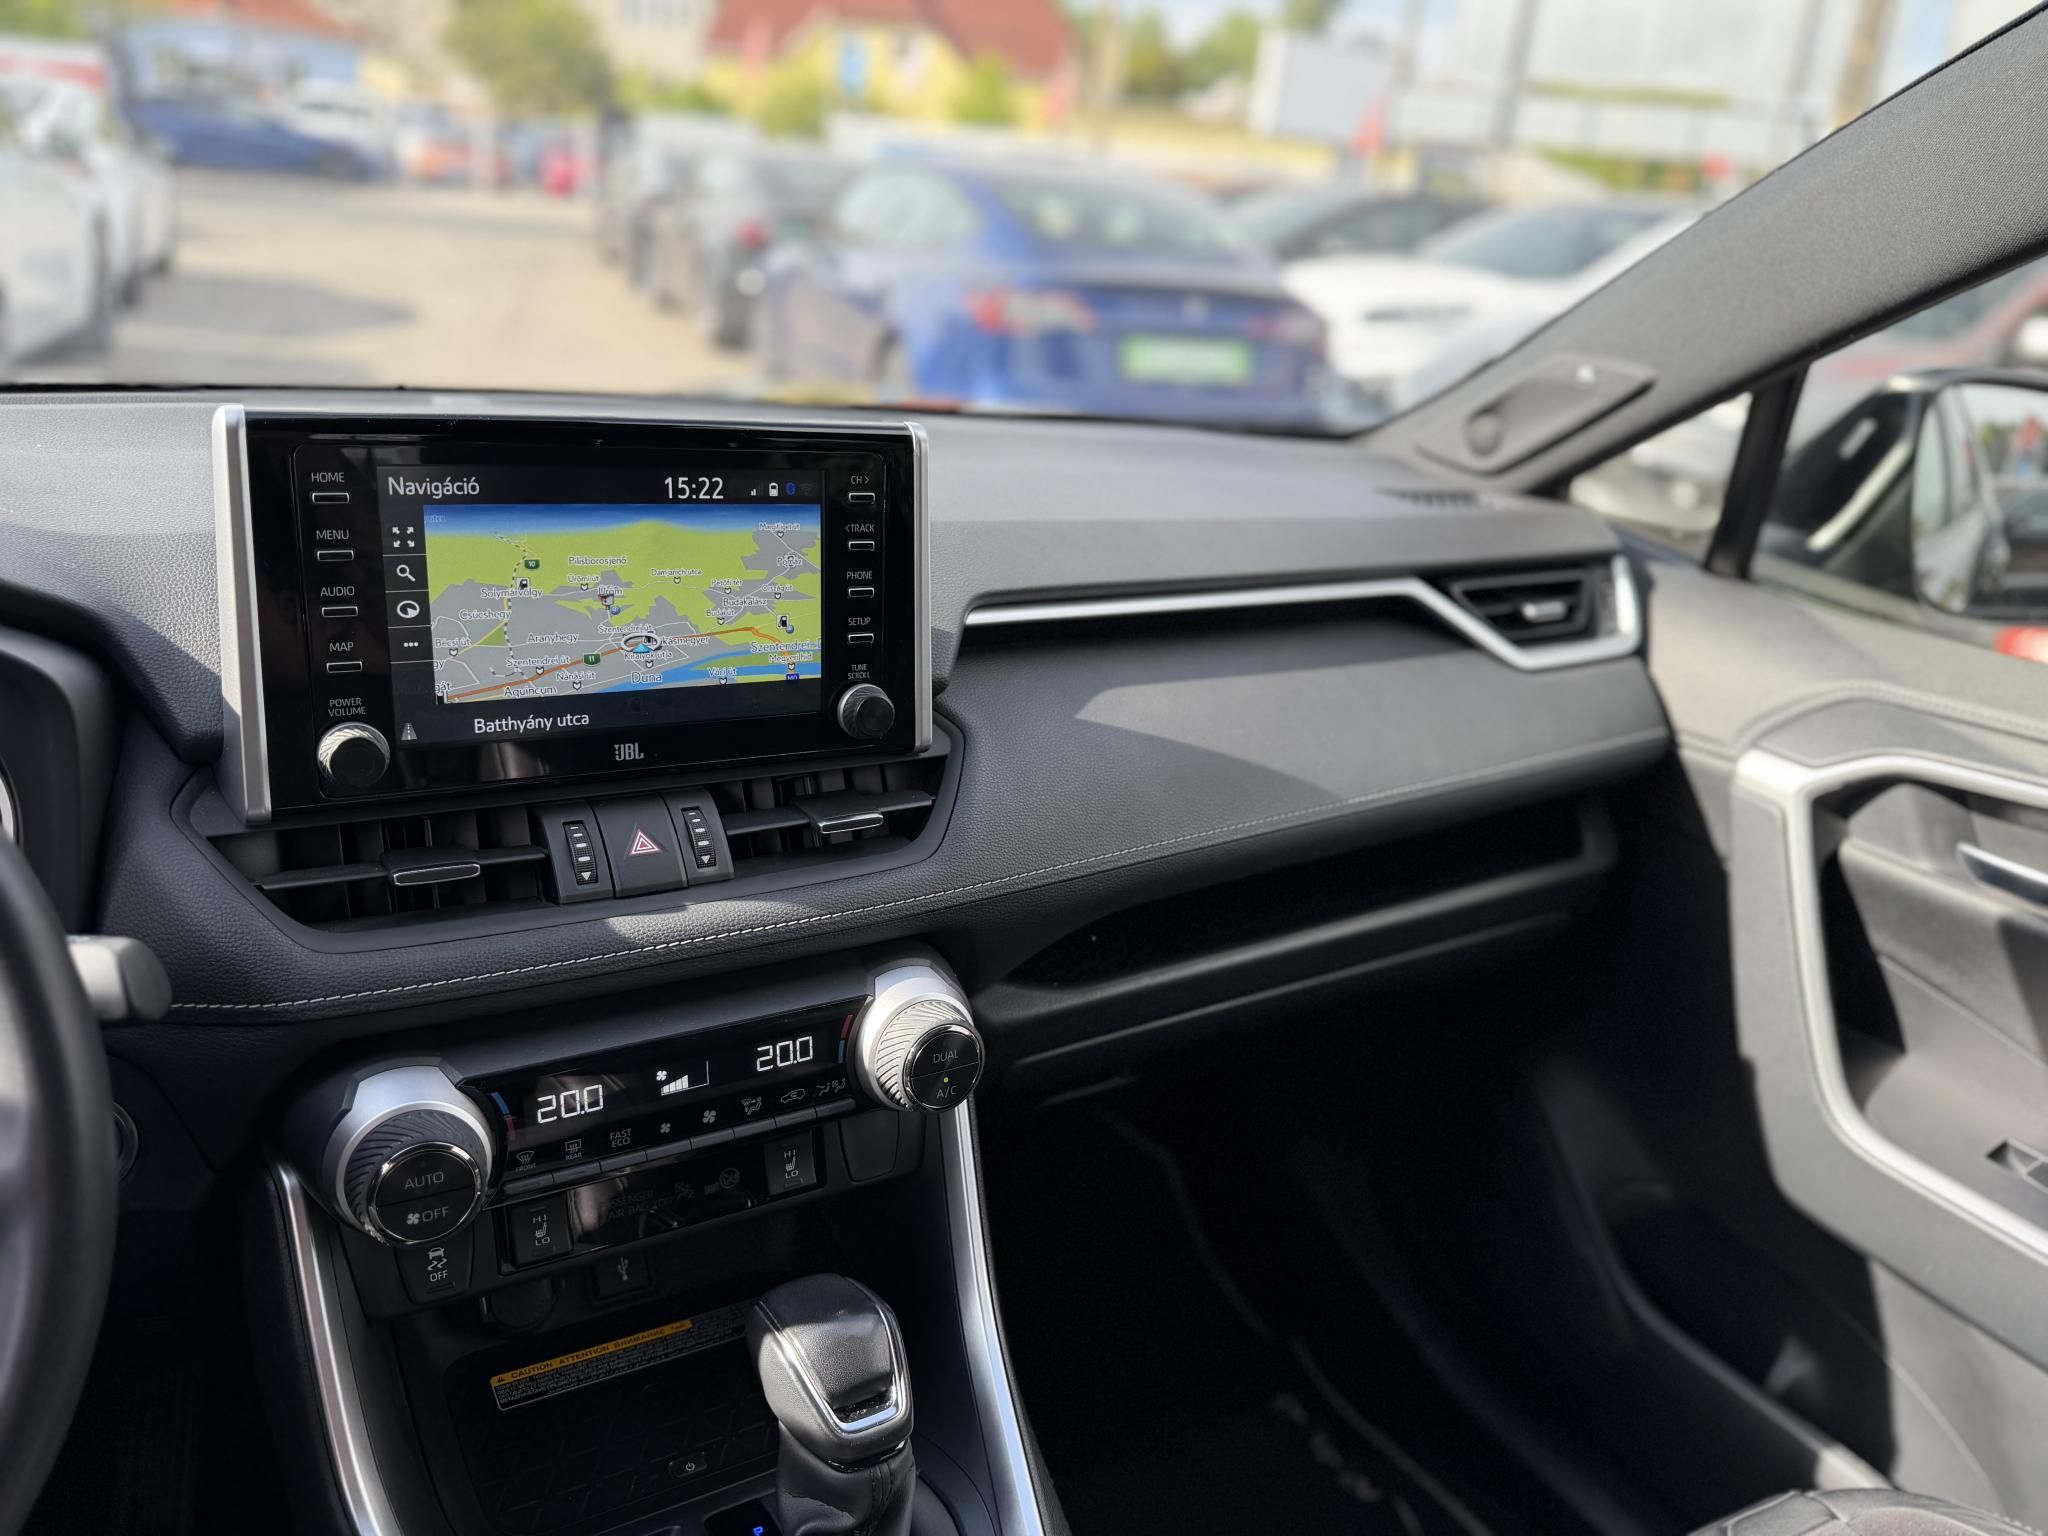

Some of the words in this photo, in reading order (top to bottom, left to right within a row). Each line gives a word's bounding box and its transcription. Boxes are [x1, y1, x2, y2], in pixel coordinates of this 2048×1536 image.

[311, 472, 345, 483] HOME
[387, 476, 480, 499] Navigáció
[664, 476, 724, 499] 15:22
[316, 530, 350, 541] MENU
[846, 571, 873, 580] PHONE
[320, 586, 355, 597] AUDIO
[848, 617, 871, 626] SETUP
[329, 641, 354, 652] MAP
[850, 663, 868, 672] TUNE
[631, 671, 663, 683] Duna
[847, 671, 870, 680] SCROLL
[329, 697, 362, 708] POWER
[328, 706, 366, 718] VOLUME
[474, 715, 553, 734] Batthyány
[557, 714, 590, 728] utca
[614, 742, 645, 761] JBL
[756, 1035, 814, 1073] 20.0
[932, 1049, 959, 1064] DUAL
[936, 1085, 957, 1099] A/C
[536, 1084, 604, 1124] 20.0
[609, 1128, 632, 1141] FAST
[611, 1136, 631, 1148] ECO
[565, 1151, 582, 1160] REAR
[515, 1162, 537, 1173] FRONT
[785, 1169, 799, 1179] LO
[404, 1171, 444, 1190] AUTO
[422, 1206, 450, 1223] OFF
[535, 1236, 550, 1247] LO
[429, 1271, 448, 1282] OFF
[511, 1362, 553, 1380] CAUTION
[558, 1344, 609, 1365] ATTENTION
